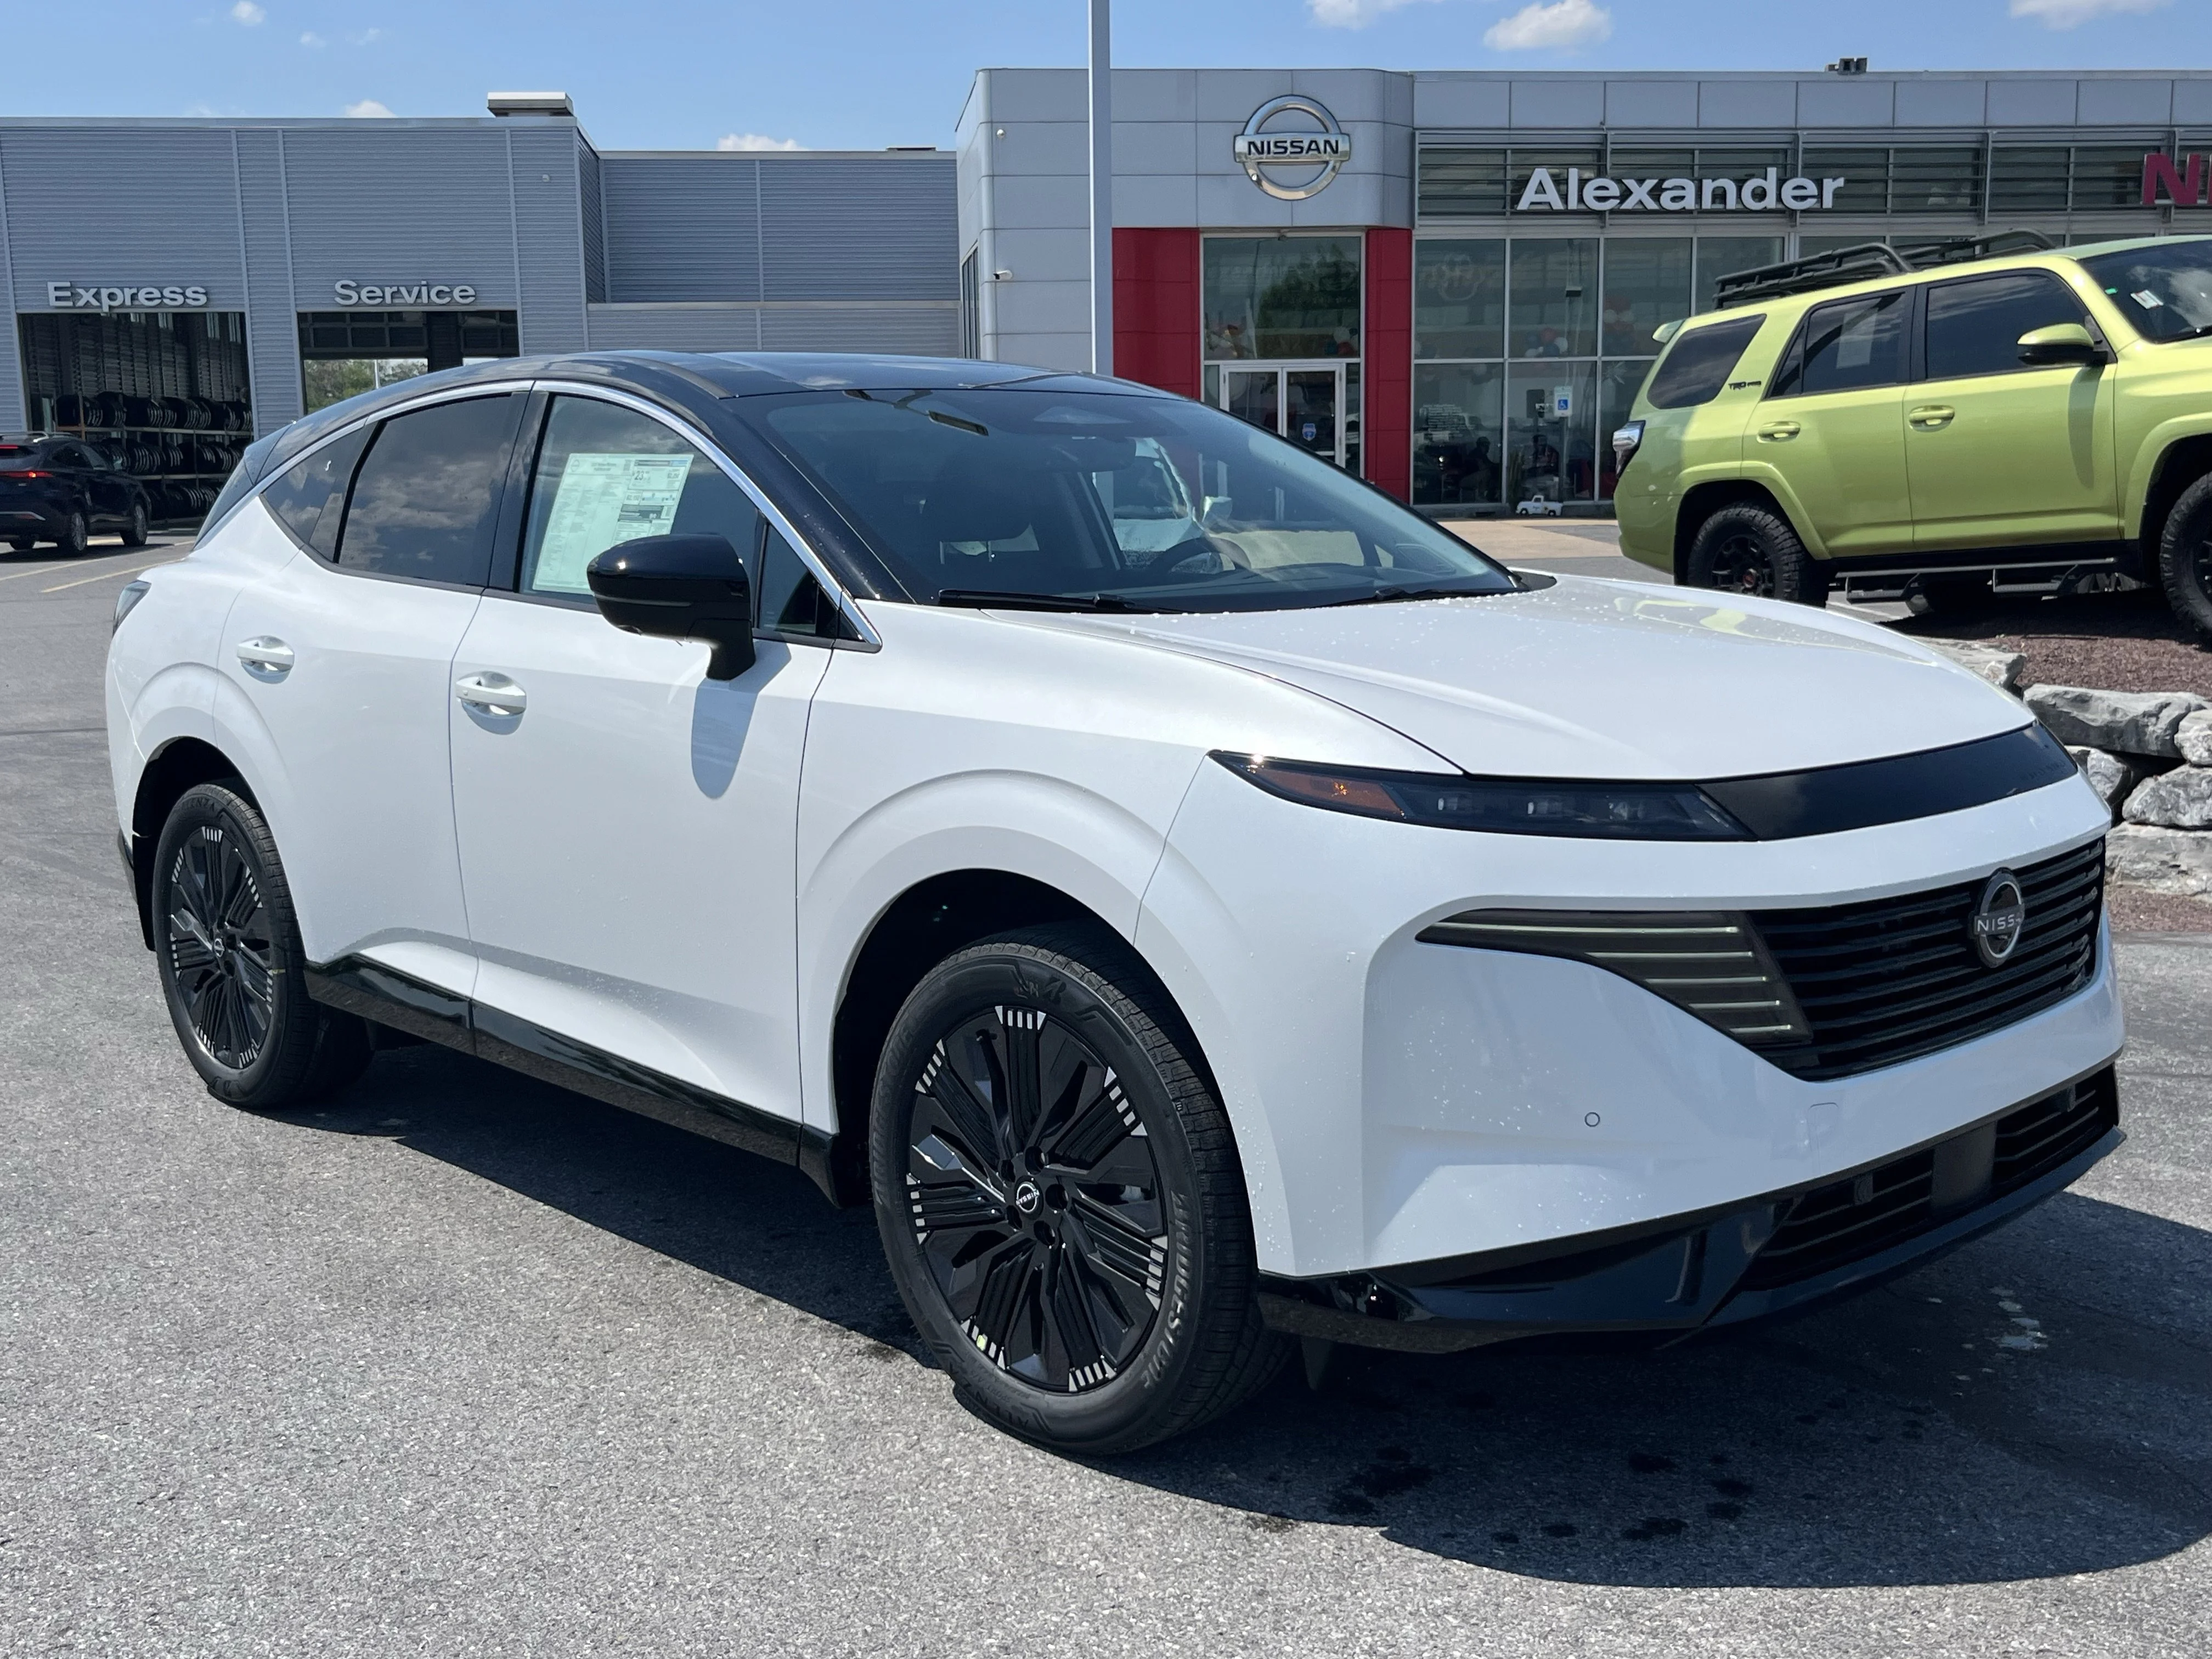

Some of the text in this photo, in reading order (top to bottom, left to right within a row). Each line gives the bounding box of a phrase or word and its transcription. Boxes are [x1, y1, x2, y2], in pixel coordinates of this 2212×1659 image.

[1247, 140, 1339, 156] NISSAN
[1516, 167, 1845, 211] Alexander
[47, 281, 207, 312] Express
[334, 280, 476, 306] Service
[1977, 913, 2022, 932] NISS
